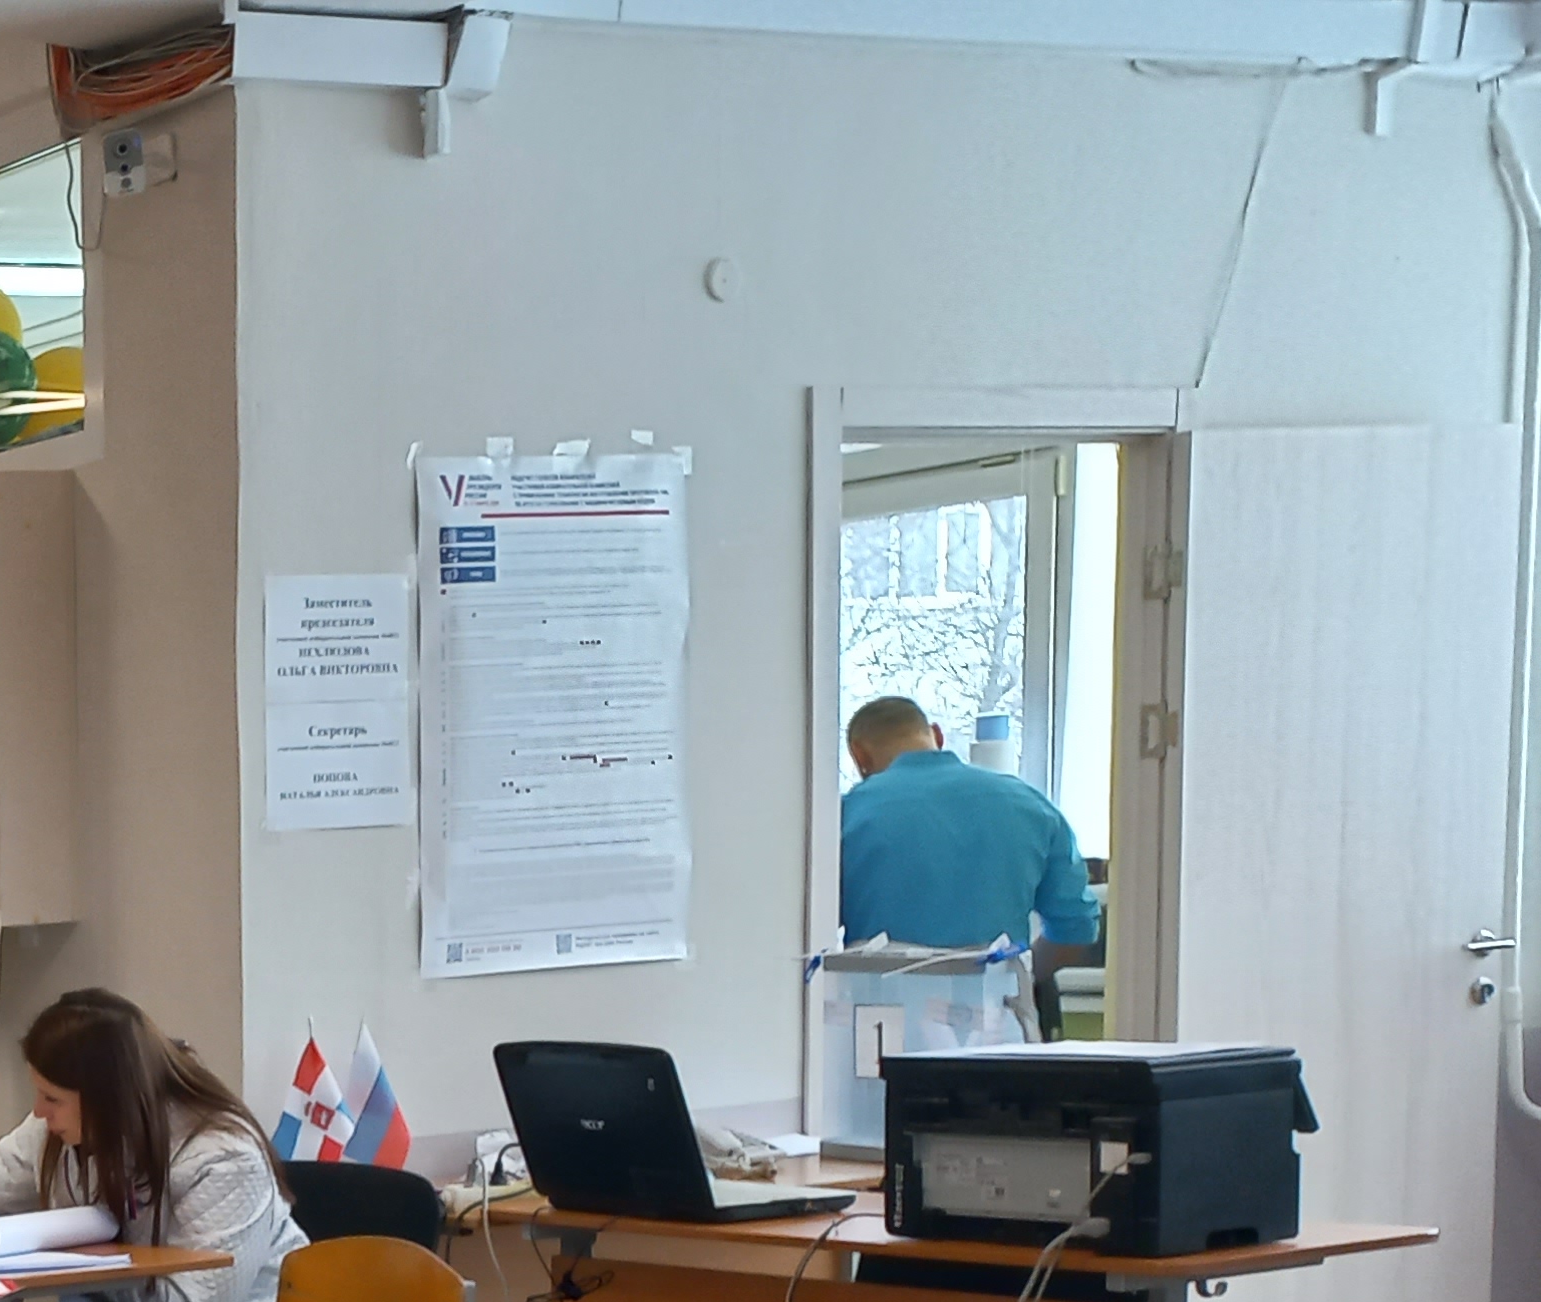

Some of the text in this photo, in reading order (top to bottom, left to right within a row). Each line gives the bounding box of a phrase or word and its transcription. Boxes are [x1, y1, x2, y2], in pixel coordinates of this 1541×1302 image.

[303, 596, 373, 609] Заместитель
[277, 662, 399, 678] ОЛЬГА ВИКТОРОВНА
[308, 724, 368, 740] Секретарь
